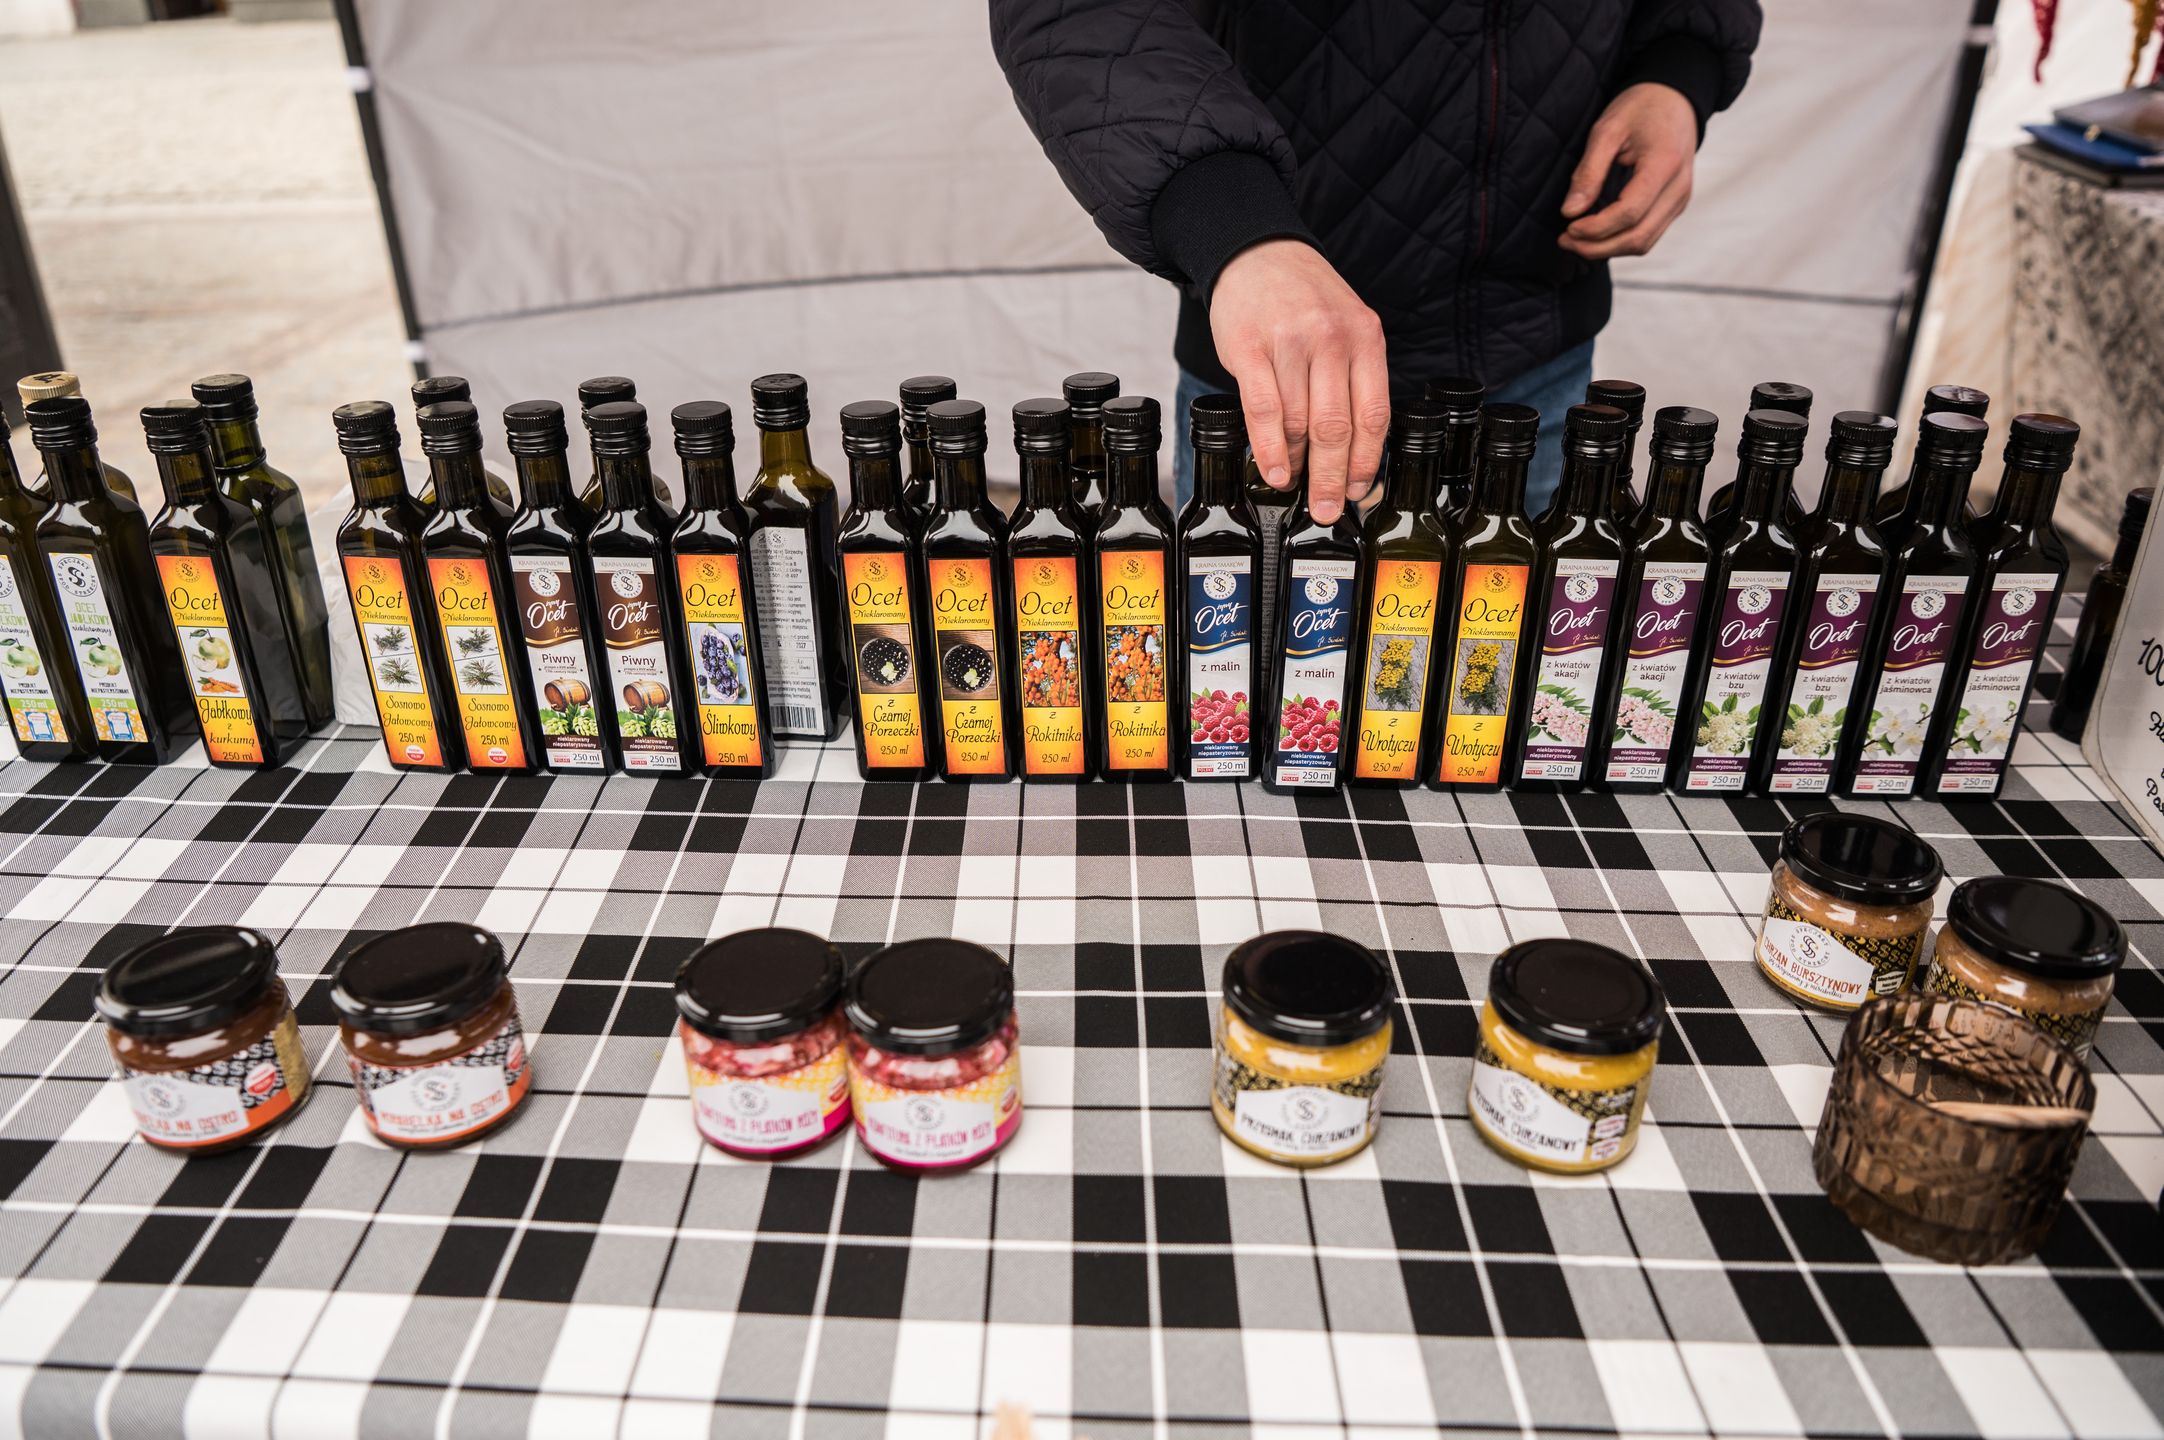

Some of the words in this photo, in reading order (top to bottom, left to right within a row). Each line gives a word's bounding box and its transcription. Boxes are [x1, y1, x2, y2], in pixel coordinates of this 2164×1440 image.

[170, 586, 219, 610] Ocet
[355, 584, 404, 609] Ocet
[438, 586, 488, 610] Ocet
[685, 583, 736, 606] Ocet
[851, 582, 904, 606] Ocet
[936, 588, 988, 612] Ocet
[1106, 585, 1160, 610] Ocet
[74, 602, 98, 614] OCET
[1020, 591, 1073, 616] Ocet
[1376, 593, 1432, 619] Ocet
[359, 610, 408, 623] Nieklarowany
[526, 600, 576, 628] Ocet
[608, 602, 658, 630] Ocet
[688, 610, 740, 620] Nieklarowany
[854, 610, 906, 619] Nieklarowany
[1464, 598, 1520, 623] Ocet
[175, 612, 225, 623] Nieklarowany
[442, 612, 493, 623] Nieklarowany
[938, 616, 991, 626] Nieklarowany
[1021, 618, 1075, 628] Nieklarowany
[1107, 612, 1161, 622] Nieklarowany
[1194, 602, 1248, 634] Ocet
[1292, 608, 1348, 638] Ocet
[1550, 606, 1607, 636] Ocet
[1375, 622, 1429, 634] Nieklarowany
[1636, 608, 1694, 639] Ocet
[1462, 626, 1517, 638] Nieklarowany
[1721, 618, 1780, 648] Ocet
[1809, 620, 1867, 650] Ocet
[1893, 622, 1952, 652] Ocet
[1982, 620, 2042, 650] Ocet
[541, 653, 576, 666] Piwny
[622, 655, 656, 668] Piwny
[1546, 661, 1552, 669] z
[1554, 659, 1591, 670] kwiatów
[1200, 663, 1207, 672] z
[1210, 661, 1240, 672] malin
[1632, 664, 1638, 672] z
[1640, 663, 1677, 673] kwiatów
[1294, 670, 1301, 678] z
[1304, 668, 1335, 678] malin
[1554, 669, 1580, 679] akacji
[1640, 672, 1666, 682] akacji
[1716, 672, 1722, 680] z
[1724, 672, 1760, 681] kwiatów
[1811, 674, 1848, 684] kwiatów
[1983, 674, 2020, 683] kwiatów
[1728, 681, 1744, 690] bzu
[1894, 676, 1932, 686] kwiatów
[1815, 684, 1831, 692] bzu
[1879, 685, 1932, 695] jaśminowca
[1968, 683, 2020, 692] jaśminowca
[22, 700, 36, 708] 250
[38, 700, 48, 708] ml
[101, 700, 116, 708] 250
[118, 700, 129, 708] ml
[385, 695, 426, 711] Sosnowo
[468, 697, 510, 712] Sosnowo
[199, 698, 253, 725] Jabłkowy
[873, 706, 911, 726] Czarnej
[382, 713, 433, 730] Jałowcowy
[464, 716, 518, 732] Jałowcowy
[702, 708, 756, 741] Śliwkowy
[954, 712, 993, 733] Czarnej
[865, 722, 920, 737] Porzeczki
[1026, 724, 1082, 744] Rokitnika
[1110, 720, 1166, 738] Rokitnika
[398, 732, 414, 743] 250
[416, 734, 426, 744] ml
[480, 734, 497, 745] 250
[498, 735, 510, 746] ml
[946, 728, 1001, 744] Porzeczki
[880, 745, 898, 755] 250
[900, 744, 909, 755] ml
[1204, 744, 1239, 752] nieklarowany
[1362, 729, 1416, 758] Wrotyczu
[1446, 733, 1500, 762] Wrotyczu
[222, 751, 240, 761] 250
[242, 751, 254, 761] ml
[961, 752, 978, 762] 250
[980, 752, 990, 762] ml
[1126, 748, 1143, 758] 250
[1144, 748, 1155, 758] ml
[1198, 750, 1246, 758] niepasteryzowany
[1529, 752, 1577, 761] niepasteryzowany
[1536, 747, 1572, 755] nieklarowany
[590, 753, 600, 762] ml
[650, 755, 666, 763] 250
[667, 755, 678, 764] ml
[718, 752, 736, 763] 250
[738, 752, 749, 764] ml
[1042, 754, 1059, 763] 250
[1060, 753, 1071, 763] ml
[1284, 758, 1332, 766] niepasteryzowany
[1216, 762, 1233, 770] 250
[1234, 761, 1246, 770] ml
[1372, 762, 1391, 772] 250
[1392, 762, 1404, 772] ml
[1456, 766, 1475, 777] 250
[1476, 766, 1488, 777] ml
[1546, 764, 1562, 774] 250
[1564, 765, 1576, 774] ml
[1630, 766, 1646, 776] 250
[1648, 768, 1660, 776] ml
[1302, 772, 1319, 780] 250
[1320, 771, 1332, 780] ml
[1712, 776, 1728, 784] 250
[1730, 775, 1742, 784] ml
[1796, 778, 1812, 787] 250
[1814, 778, 1826, 787] ml
[1877, 780, 1894, 788] 250
[1896, 779, 1908, 788] ml
[1963, 778, 1980, 786] 250
[1982, 778, 1994, 786] ml
[1790, 962, 1862, 995] BURSZTYNOWY
[1241, 1113, 1294, 1142] PRZYSMAK
[1300, 1122, 1361, 1144] CHRZANOWY
[1510, 1121, 1578, 1152] CHRZANOWY
